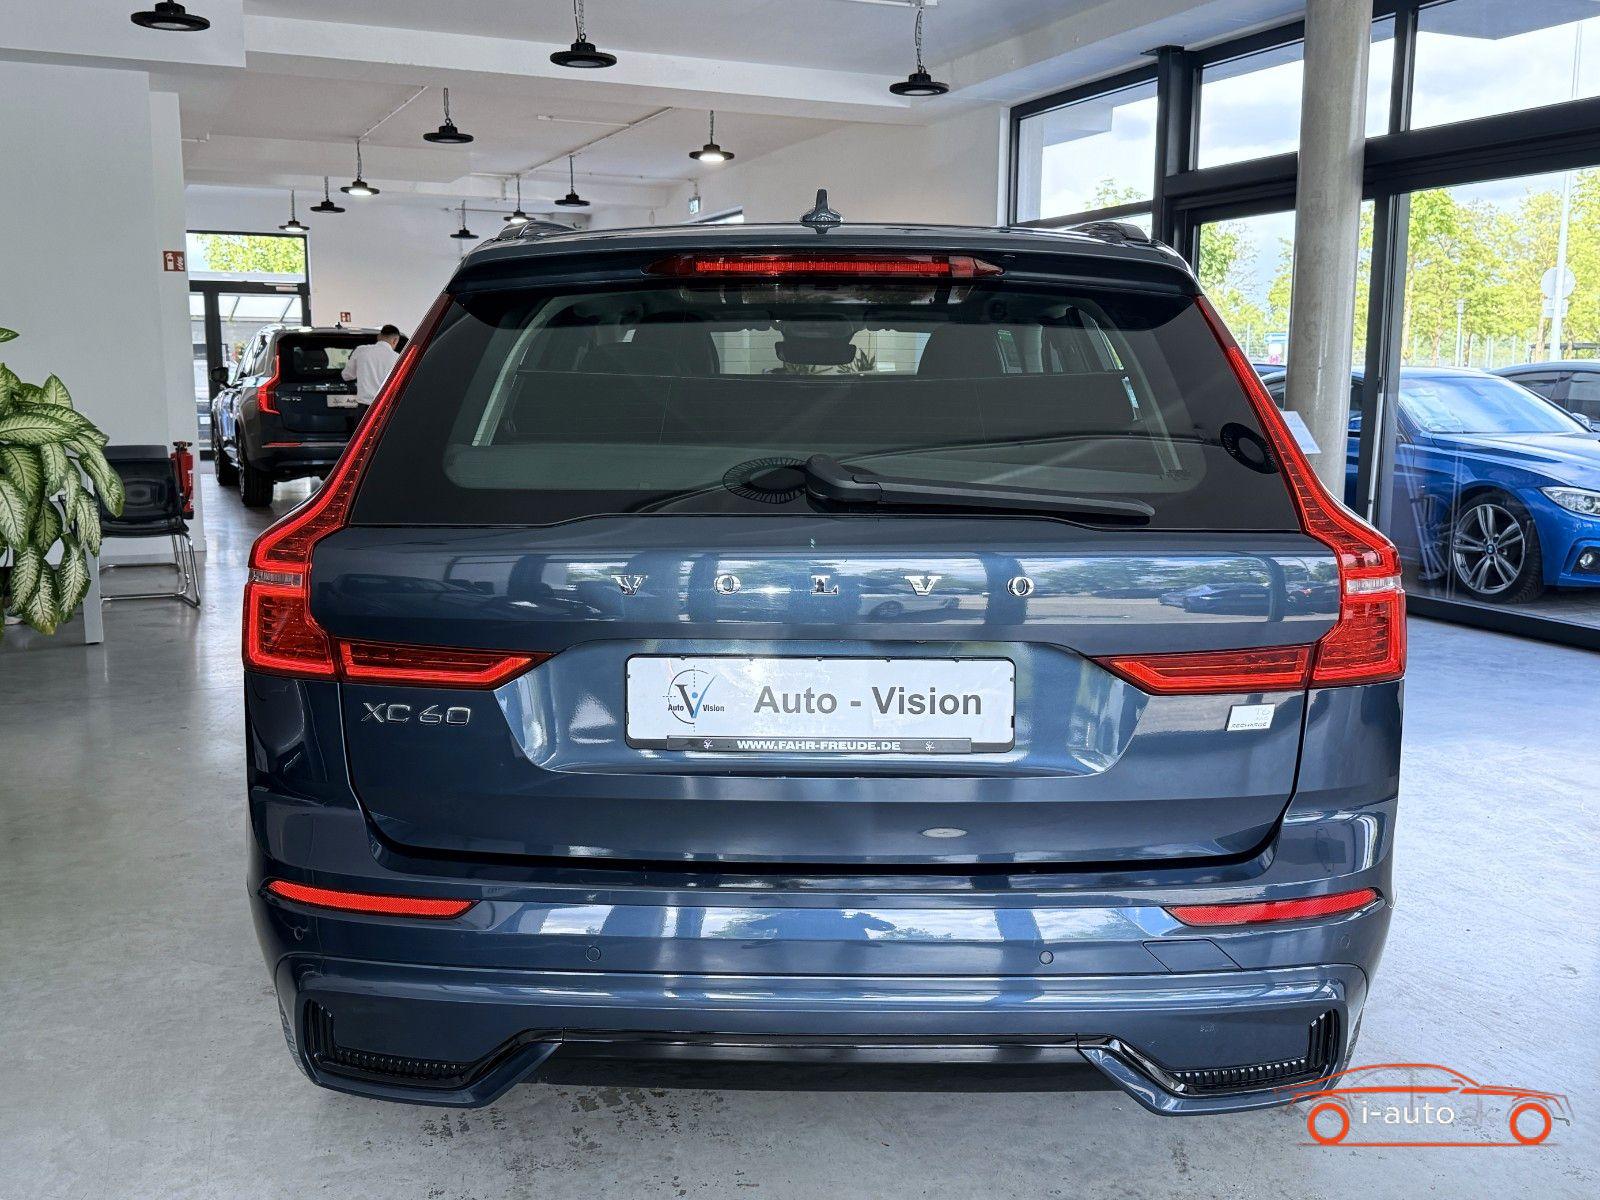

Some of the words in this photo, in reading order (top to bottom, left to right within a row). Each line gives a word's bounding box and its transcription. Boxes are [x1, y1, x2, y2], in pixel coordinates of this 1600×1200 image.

[610, 574, 1035, 597] VOLVO
[668, 704, 685, 712] Auto
[702, 704, 725, 712] Vision
[753, 685, 838, 714] Auto
[871, 686, 982, 715] Vision
[736, 739, 901, 751] WWW.FAHR-FREUDE.DE
